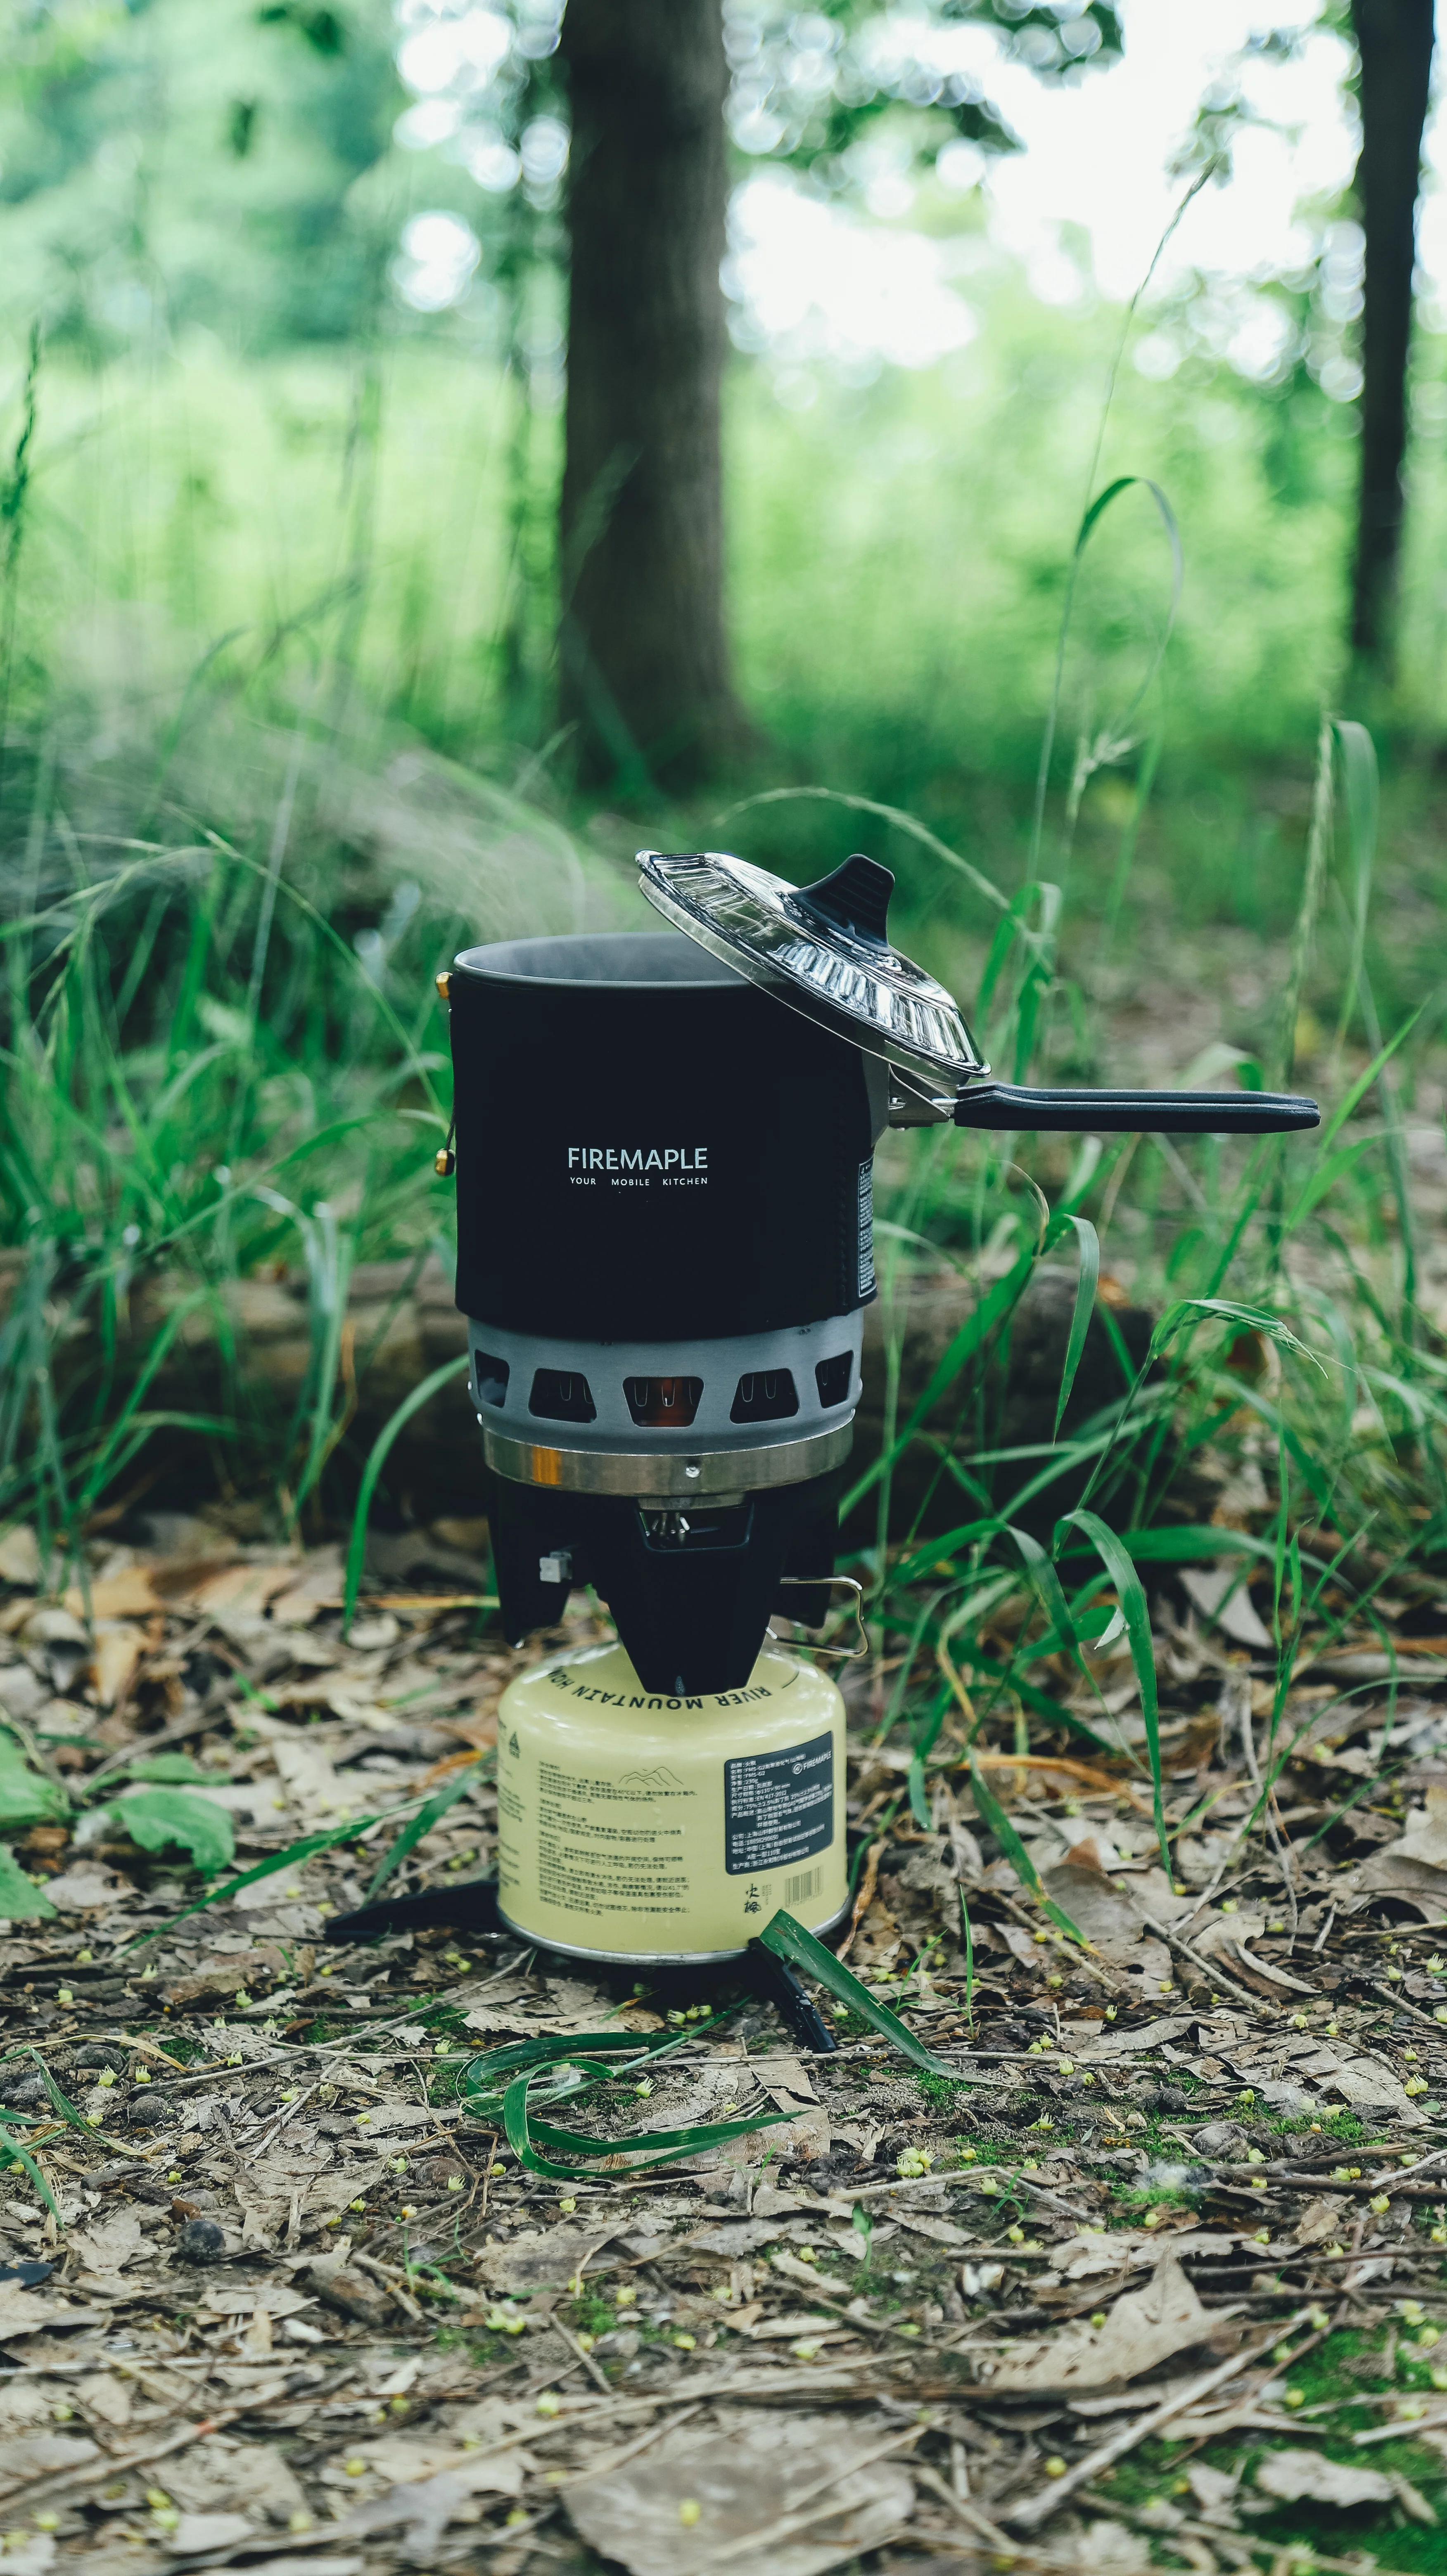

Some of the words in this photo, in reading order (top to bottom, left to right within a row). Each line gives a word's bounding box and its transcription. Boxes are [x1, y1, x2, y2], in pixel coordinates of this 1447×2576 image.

[569, 1148, 708, 1170] FIREMAPLE
[663, 1177, 708, 1186] KITCHEN
[572, 1686, 704, 1710] MOUNTAIN
[715, 1686, 773, 1707] RIVER
